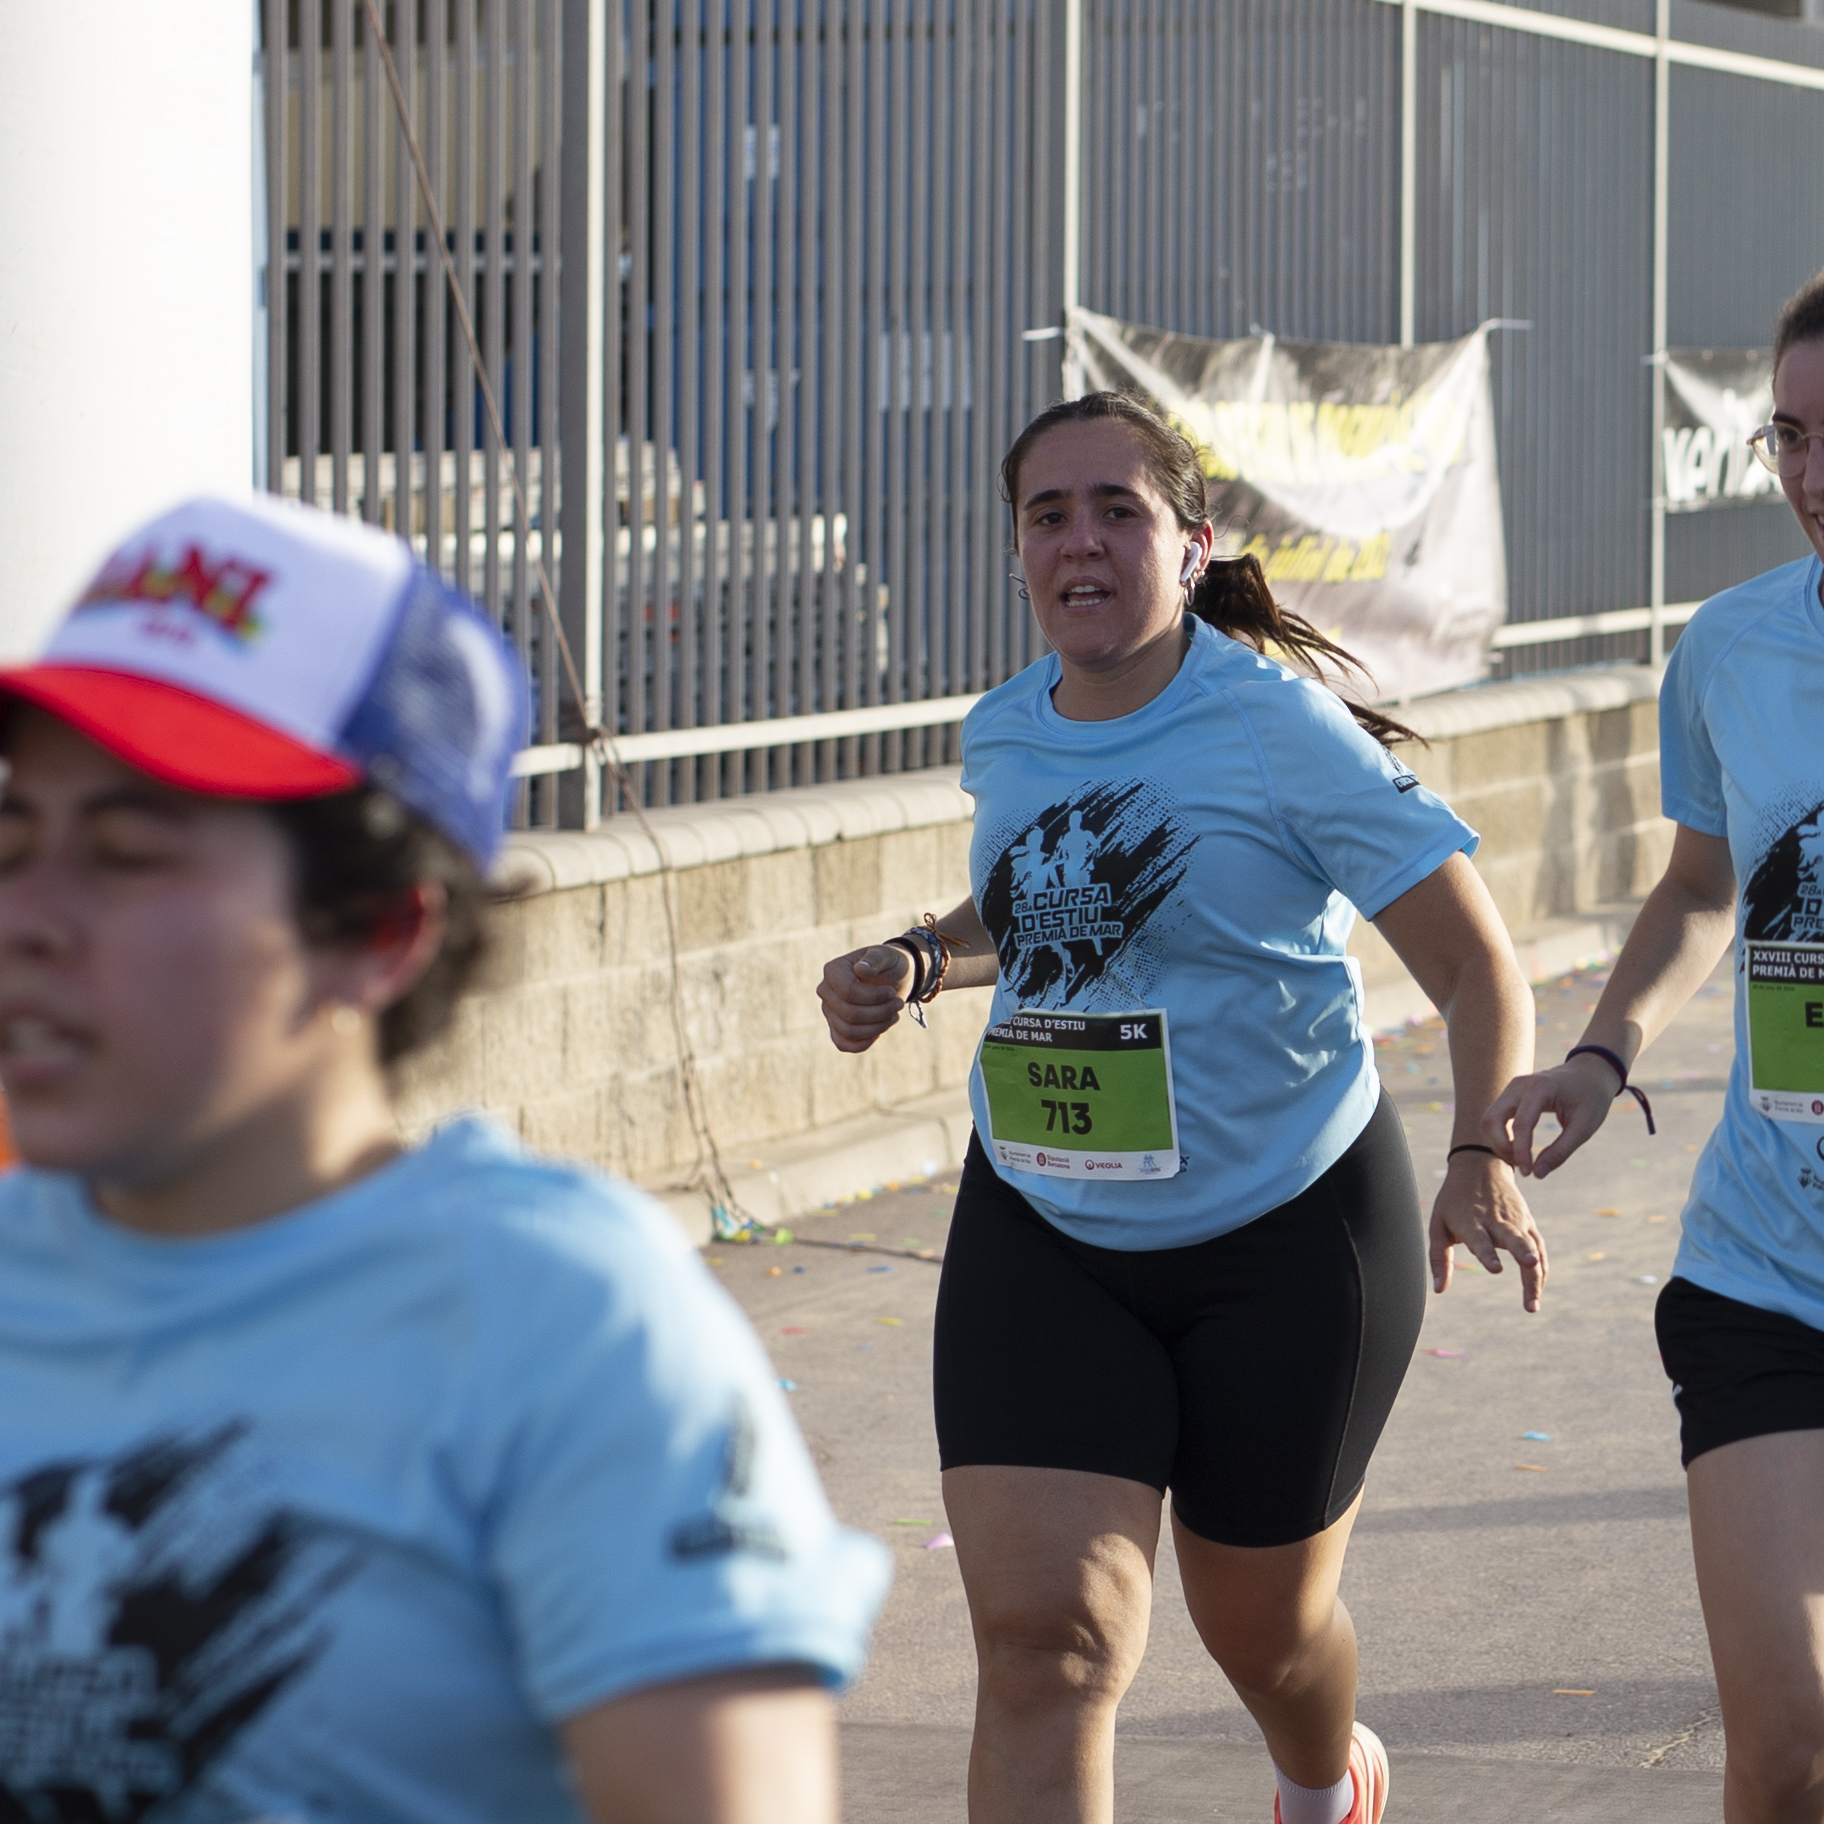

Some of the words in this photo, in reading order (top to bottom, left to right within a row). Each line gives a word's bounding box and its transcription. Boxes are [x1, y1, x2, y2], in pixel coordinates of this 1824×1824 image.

[1033, 886, 1109, 911] CURSA
[1021, 907, 1099, 932] D'ESTIU
[1070, 925, 1088, 936] DE
[1090, 924, 1121, 936] MAR
[1753, 950, 1791, 964] XXVIII
[1752, 963, 1797, 978] PREMIÀ
[1799, 966, 1815, 979] DE
[1013, 1016, 1042, 1029] CURSA
[1044, 1018, 1086, 1031] D'ESTIU
[1120, 1023, 1148, 1040] 5K
[1016, 1030, 1029, 1041] DE
[1031, 1031, 1053, 1043] MAR
[1027, 1061, 1101, 1091] SARA
[1040, 1098, 1093, 1136] 713
[1094, 1162, 1123, 1170] VEOLIA
